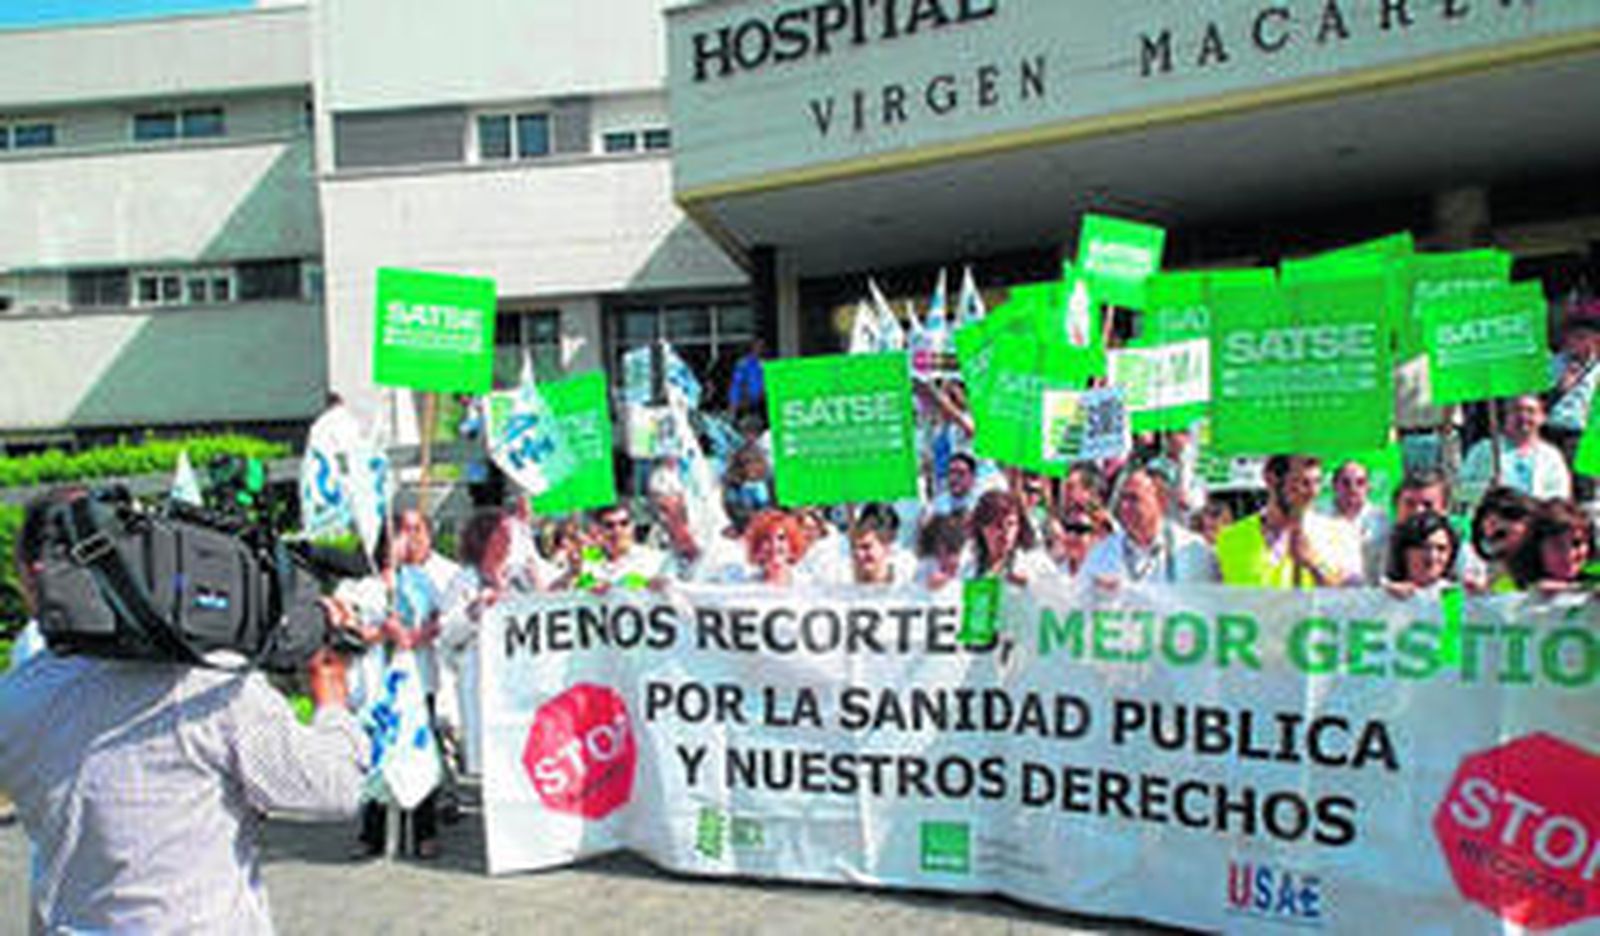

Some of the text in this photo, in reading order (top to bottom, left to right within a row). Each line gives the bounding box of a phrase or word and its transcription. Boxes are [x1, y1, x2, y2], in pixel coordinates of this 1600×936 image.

[811, 56, 1047, 137] VIRGEN
[386, 301, 484, 328] SATSE
[1224, 322, 1378, 364] SATSE
[1437, 313, 1532, 346] SATSE
[783, 391, 902, 426] SATSE
[504, 605, 678, 658] MENOS
[1036, 608, 1262, 672] MEJOR
[645, 682, 1400, 772] POR LA SANIDAD PUBLICA
[677, 745, 707, 788] Y
[725, 747, 1006, 801] NUESTROS
[1020, 761, 1358, 848] DERECHOS
[1227, 861, 1323, 918] USAE
